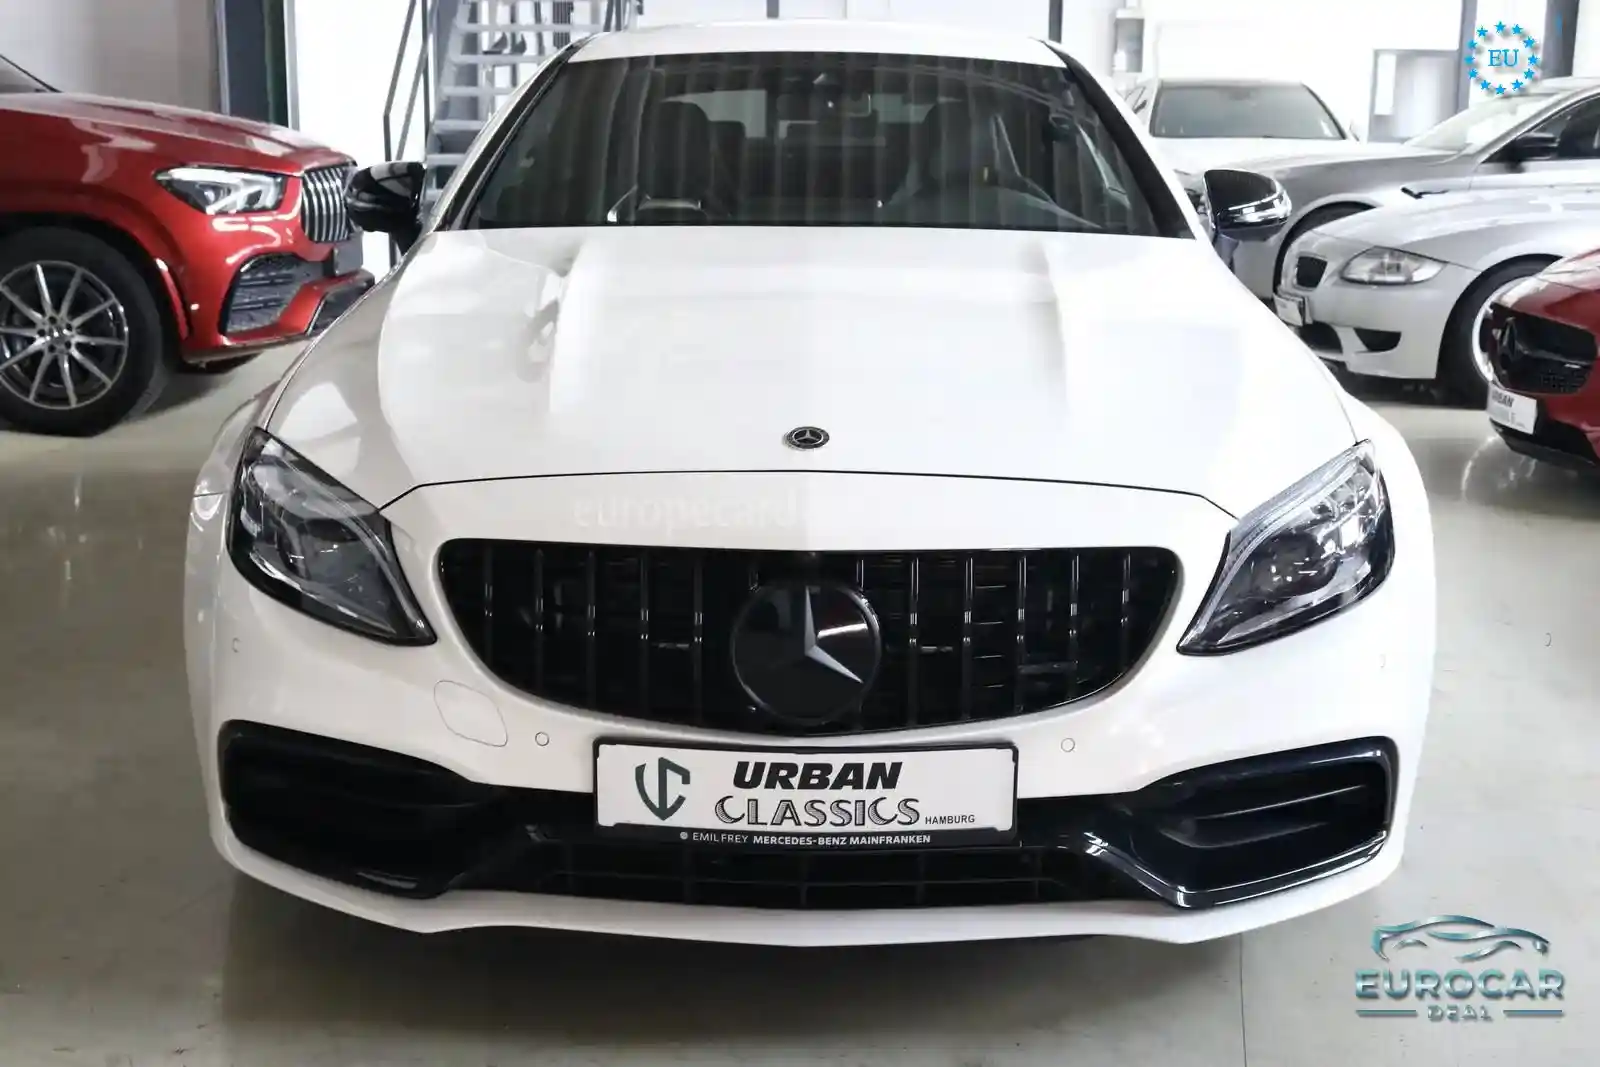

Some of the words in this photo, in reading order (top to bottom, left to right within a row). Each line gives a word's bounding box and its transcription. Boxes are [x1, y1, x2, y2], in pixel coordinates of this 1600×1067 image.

[733, 761, 903, 790] URBAN
[714, 795, 920, 827] CLASSICS
[925, 815, 975, 825] HAMBURG
[753, 835, 847, 846] MERCEDES-BENZ
[849, 834, 931, 845] MAINFRANKEN
